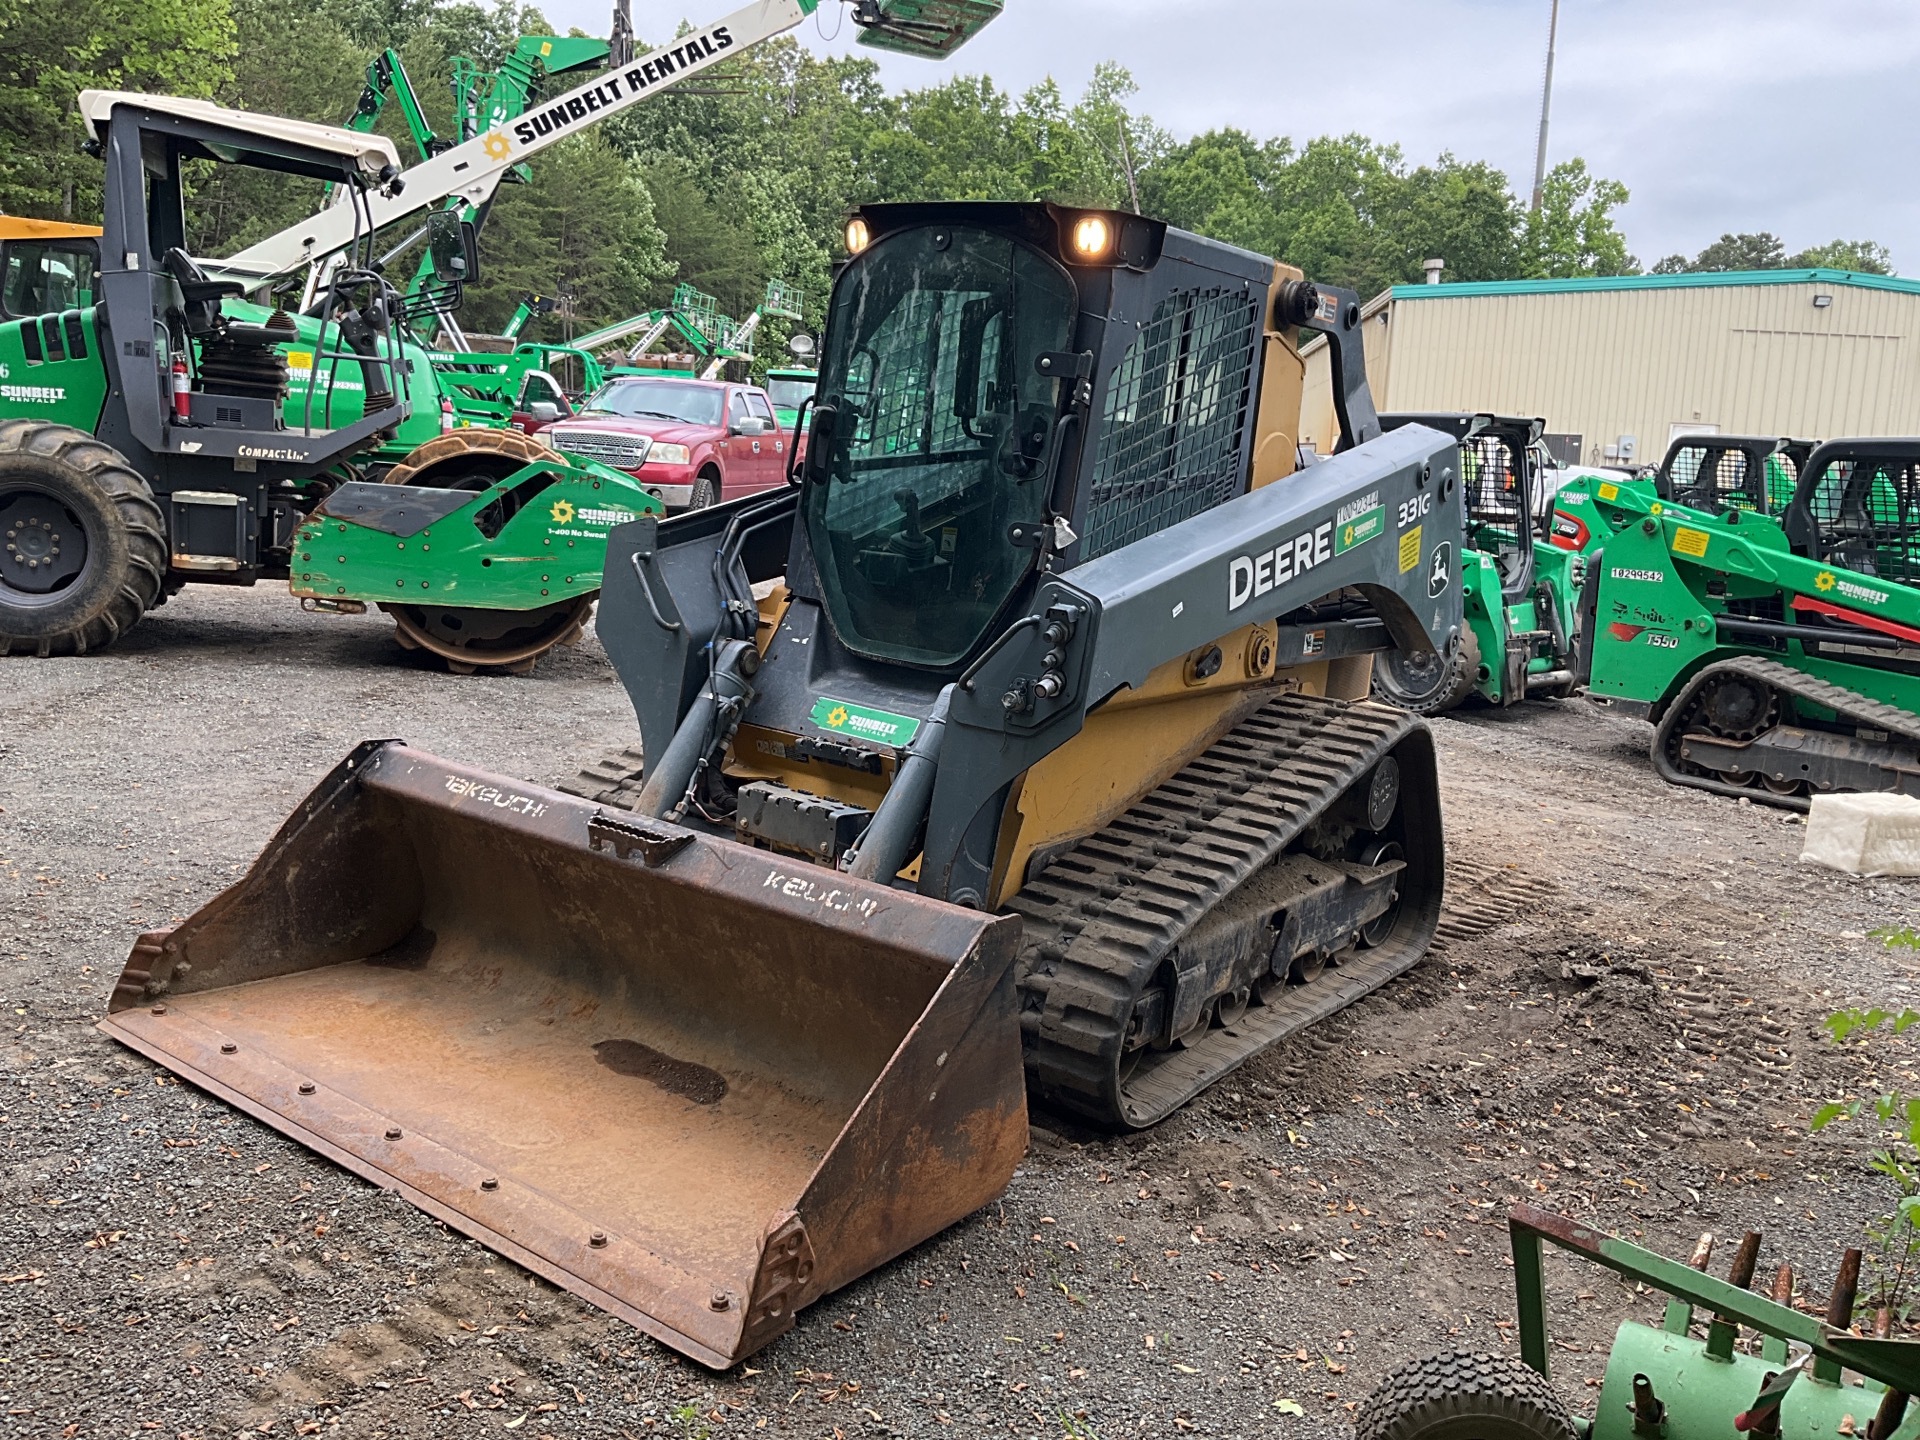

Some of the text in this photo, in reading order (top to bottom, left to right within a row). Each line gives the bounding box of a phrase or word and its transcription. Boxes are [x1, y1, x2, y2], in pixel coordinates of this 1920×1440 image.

[514, 26, 734, 146] SUNBELT RENTALS
[0, 384, 65, 399] SUNBELT
[9, 396, 56, 404] RENTALS
[1398, 492, 1431, 529] 331G
[571, 528, 582, 537] No
[1229, 520, 1333, 612] DEERE
[1612, 568, 1663, 582] 10299542
[1837, 580, 1889, 603] SUNBELT
[1842, 591, 1879, 605] RENTALS
[1645, 632, 1680, 649] T550
[848, 714, 898, 735] SUNBELT
[852, 725, 886, 737] RENTALS
